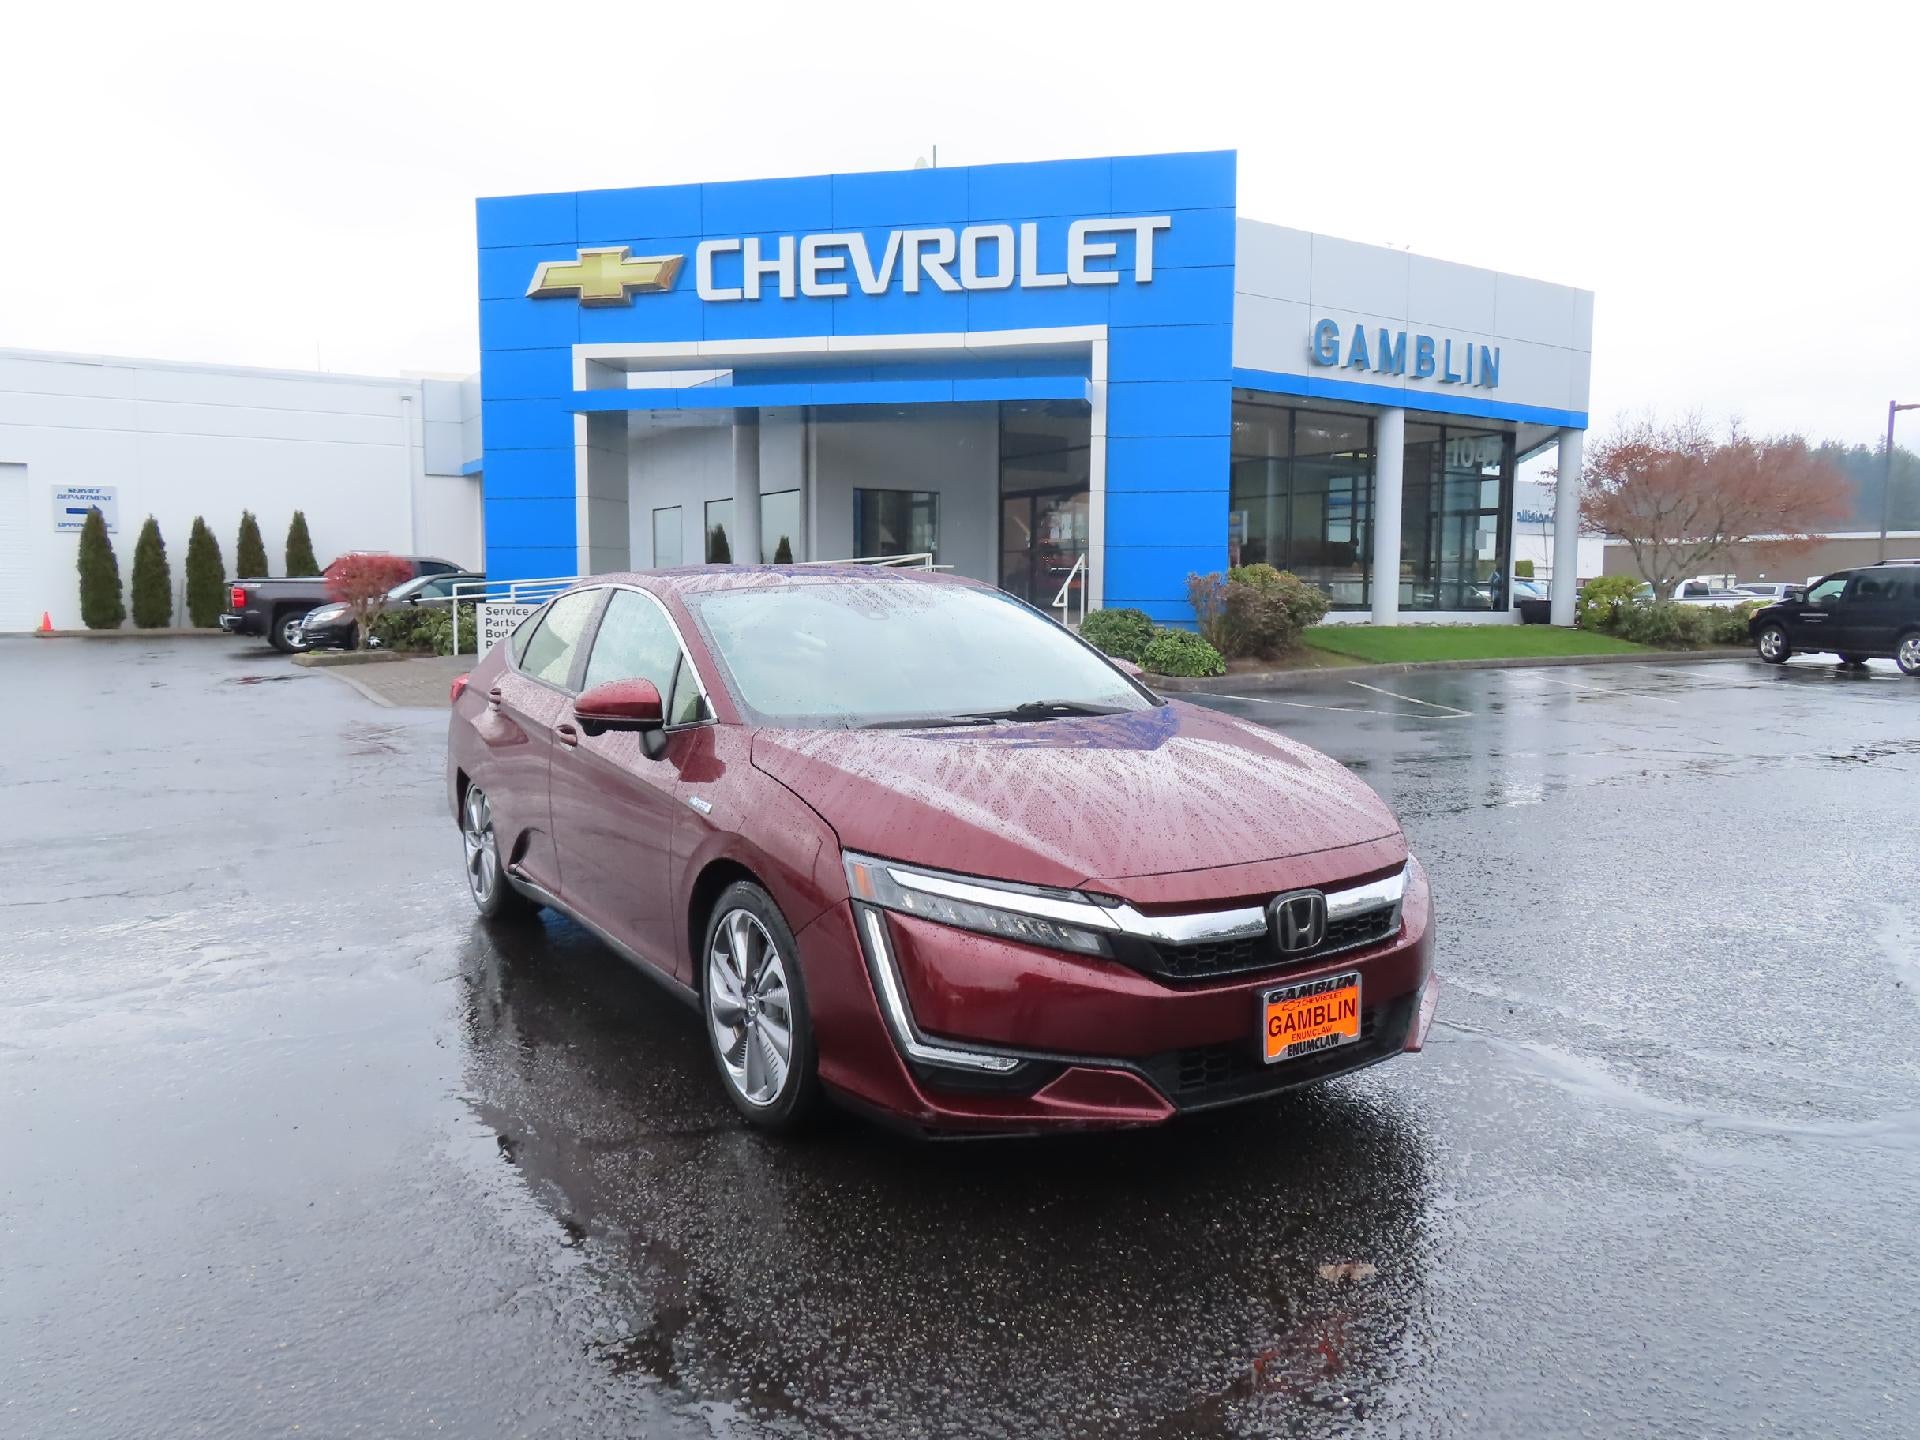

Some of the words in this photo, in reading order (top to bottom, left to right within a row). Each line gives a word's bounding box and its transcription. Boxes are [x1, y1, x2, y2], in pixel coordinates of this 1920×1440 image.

[696, 215, 1172, 302] CHEVROLET
[1309, 318, 1500, 389] GAMBLIN
[485, 606, 530, 616] Service
[485, 618, 517, 627] Parts
[485, 629, 510, 638] Bod
[1268, 974, 1358, 1004] GAMBLIN
[1268, 998, 1357, 1037] GAMBLIN
[1287, 1032, 1340, 1057] ENUMCLAW
[1291, 1024, 1333, 1042] ENUMCLAW
